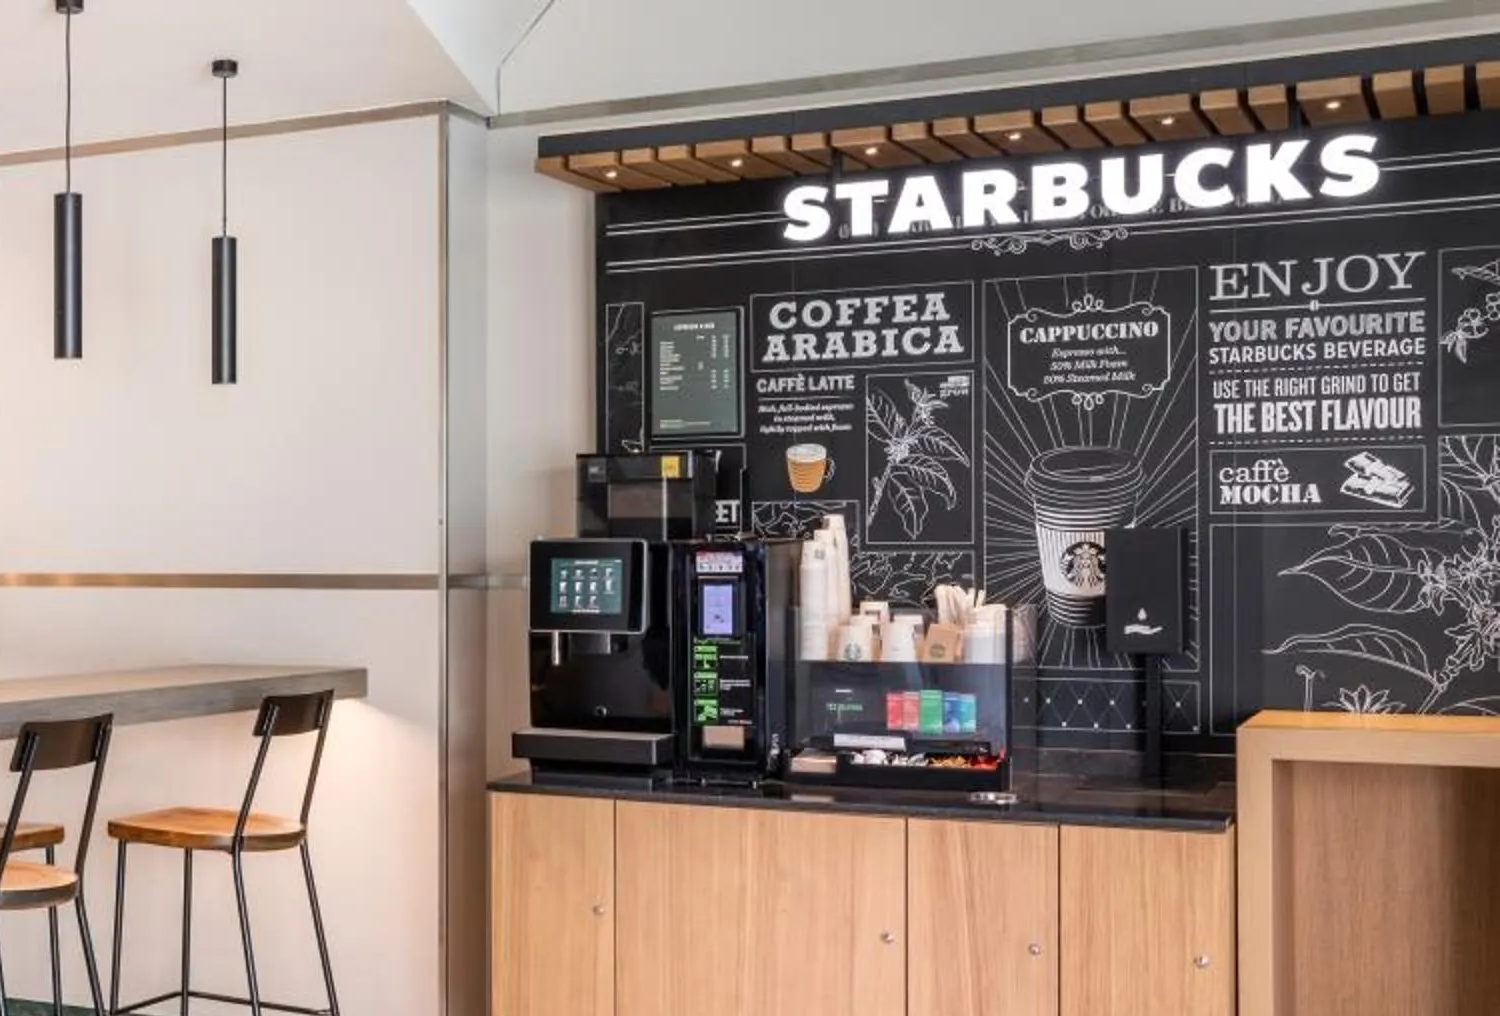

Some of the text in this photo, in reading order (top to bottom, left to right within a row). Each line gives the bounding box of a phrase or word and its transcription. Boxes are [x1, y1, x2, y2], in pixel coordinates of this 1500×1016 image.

[783, 133, 1380, 241] STARBUCKS
[1209, 251, 1427, 300] ENJOY
[769, 292, 950, 329] COFFEA
[1019, 321, 1159, 344] CAPPUCCINO
[1209, 310, 1426, 342] YOUR FAVOURITE
[761, 325, 965, 362] ARABICA
[1209, 337, 1426, 365] STARBUCKS BEVERAGE
[756, 374, 856, 393] CAFFÈ LATTE
[1213, 371, 1420, 399] USE THE RIGHT GRIND TO GET
[1213, 395, 1422, 434] THE BEST FLAVOUR
[1219, 457, 1291, 483] caffè
[1219, 483, 1322, 505] MOCHA
